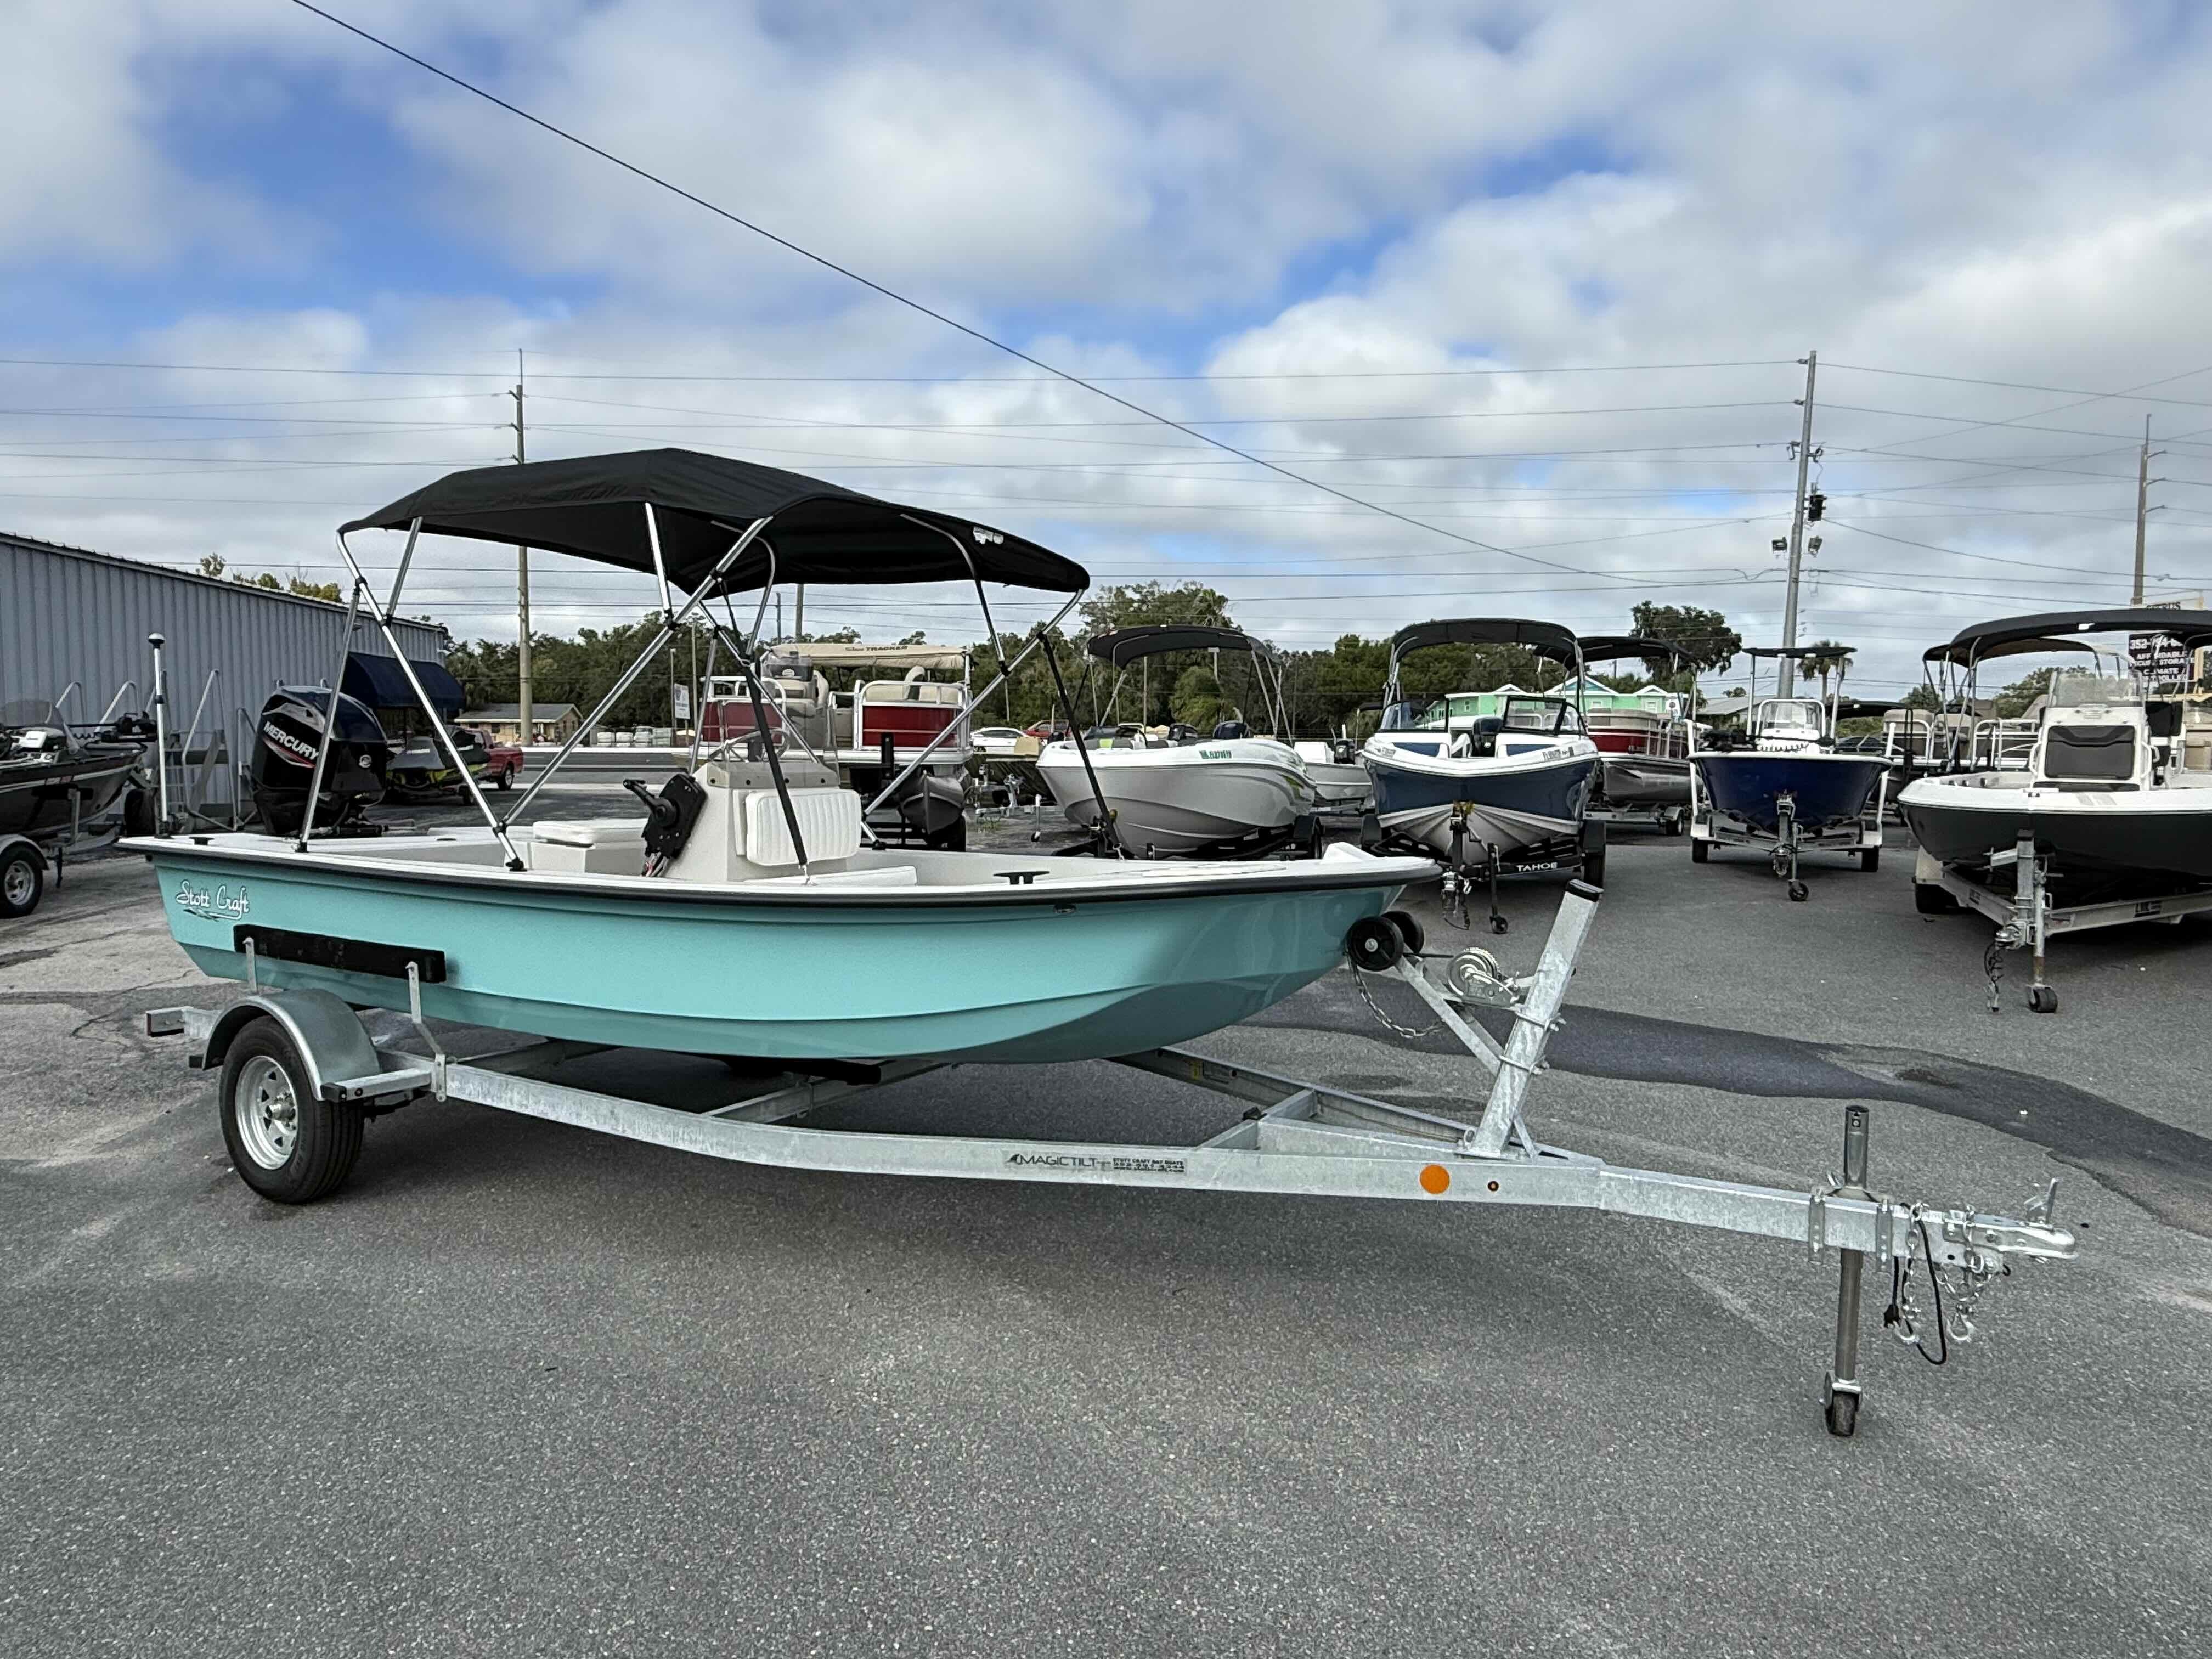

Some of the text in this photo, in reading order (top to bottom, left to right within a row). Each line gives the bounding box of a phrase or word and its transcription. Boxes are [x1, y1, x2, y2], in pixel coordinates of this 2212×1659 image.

[263, 721, 319, 760] MERCURY
[1516, 861, 1558, 872] TAHOE
[176, 880, 249, 920] Stott Craft
[1017, 1154, 1097, 1168] MAGICTILT
